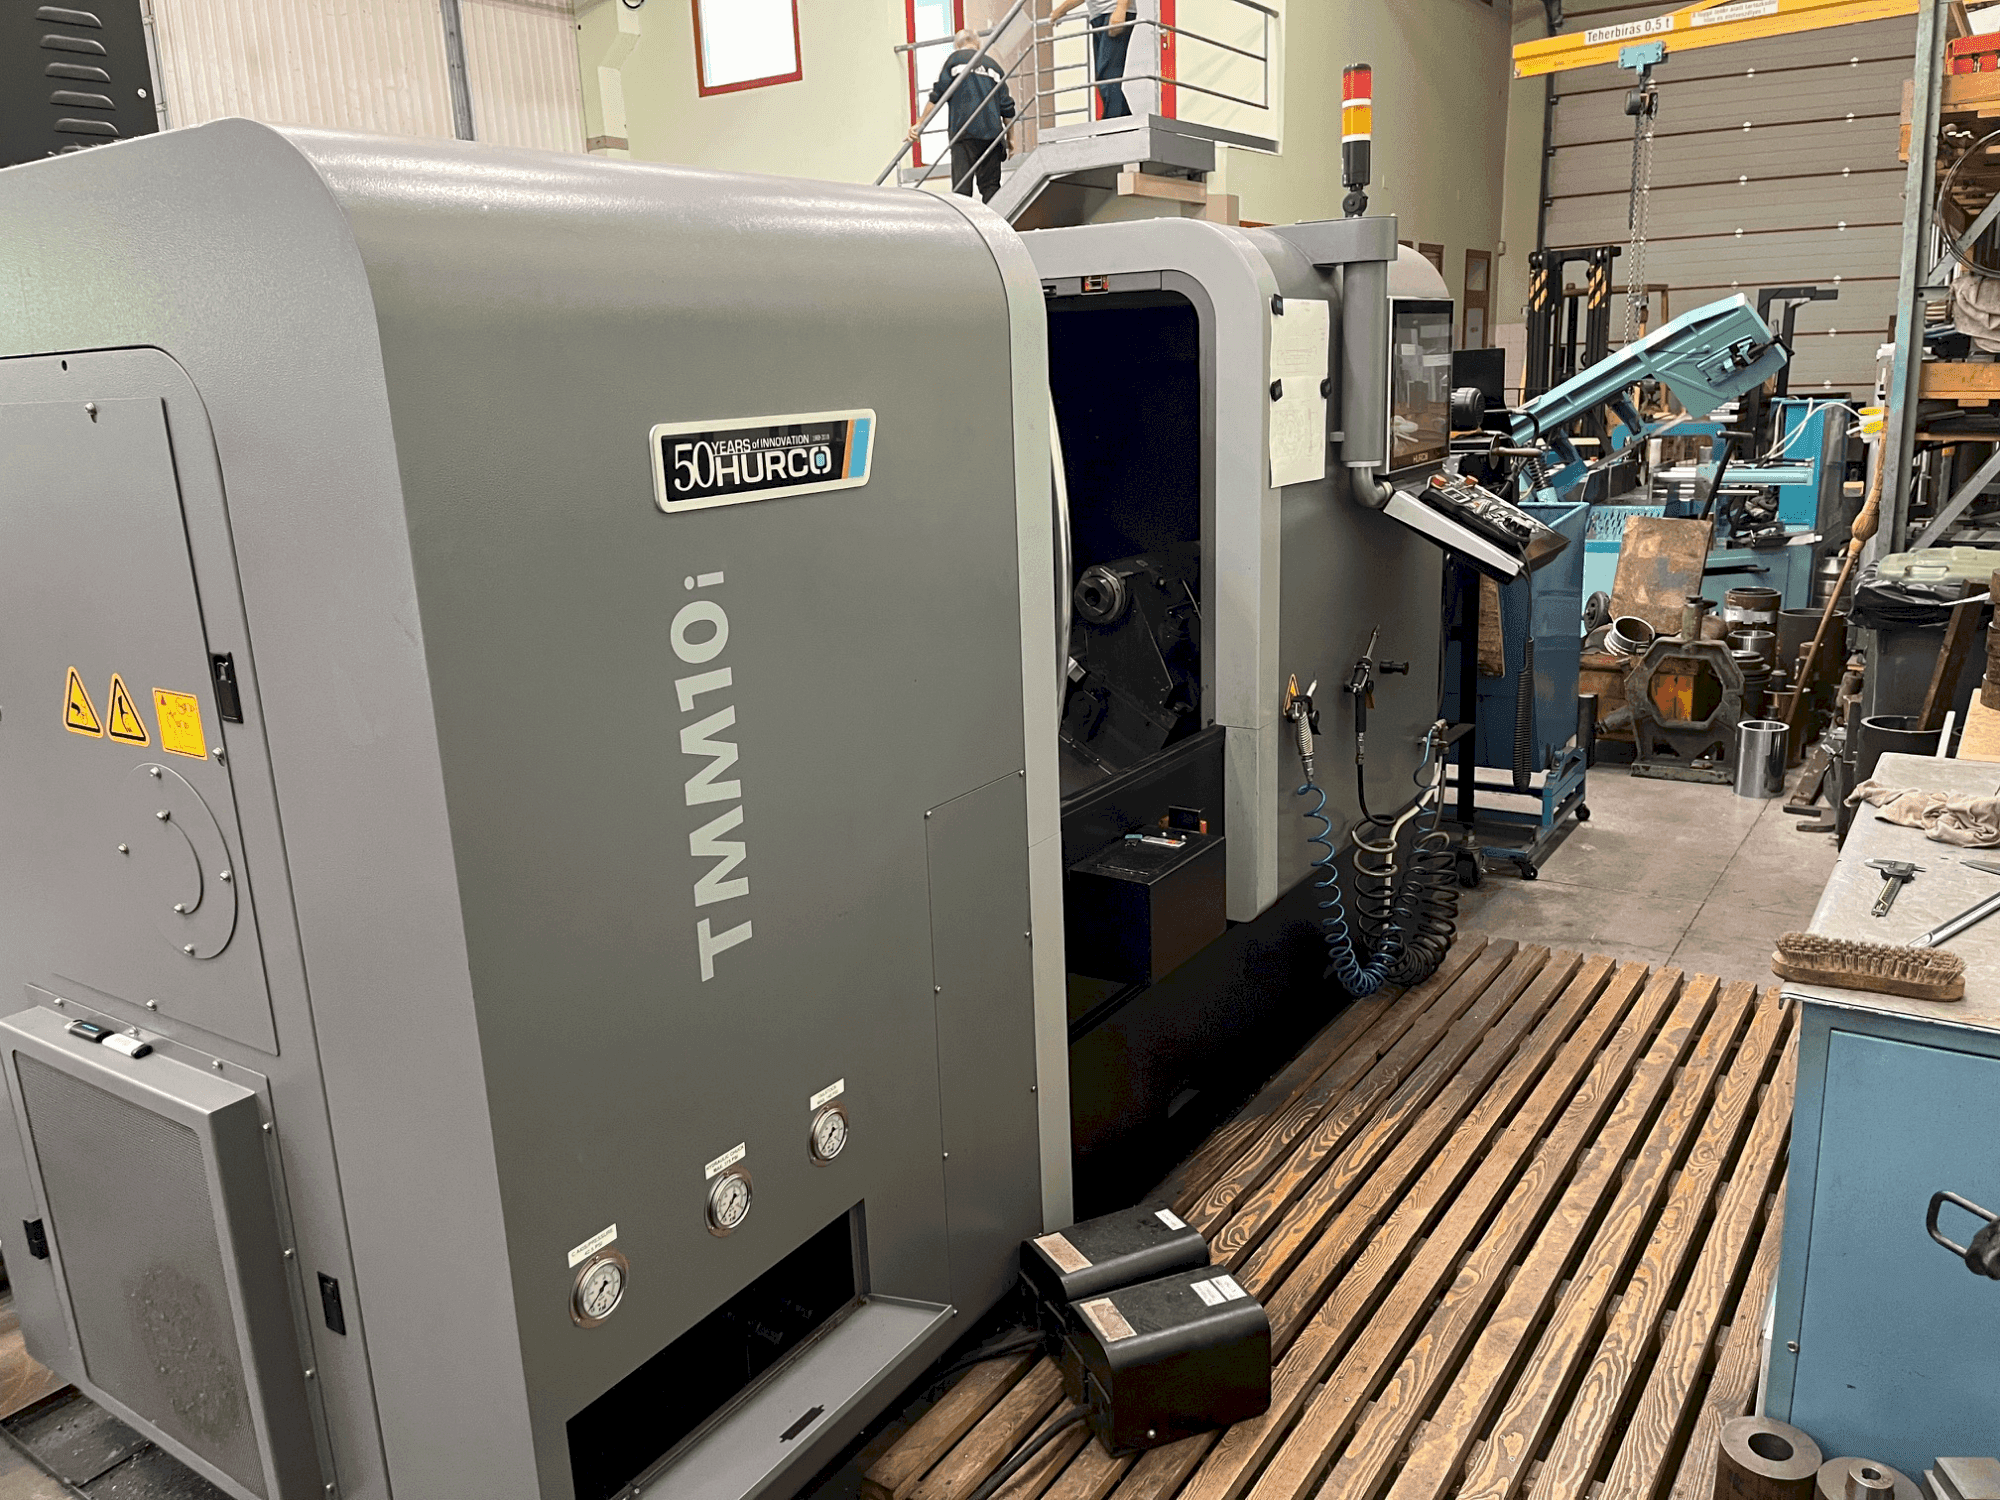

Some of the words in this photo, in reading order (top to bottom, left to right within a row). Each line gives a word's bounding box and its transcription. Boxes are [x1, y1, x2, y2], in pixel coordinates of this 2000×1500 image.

[1645, 19, 1662, 32] 0,5
[1666, 17, 1670, 28] t
[674, 441, 715, 492] 50
[711, 438, 751, 455] YEARS
[751, 438, 760, 450] of
[760, 434, 810, 449] INNOVATION
[715, 445, 832, 487] HURCO
